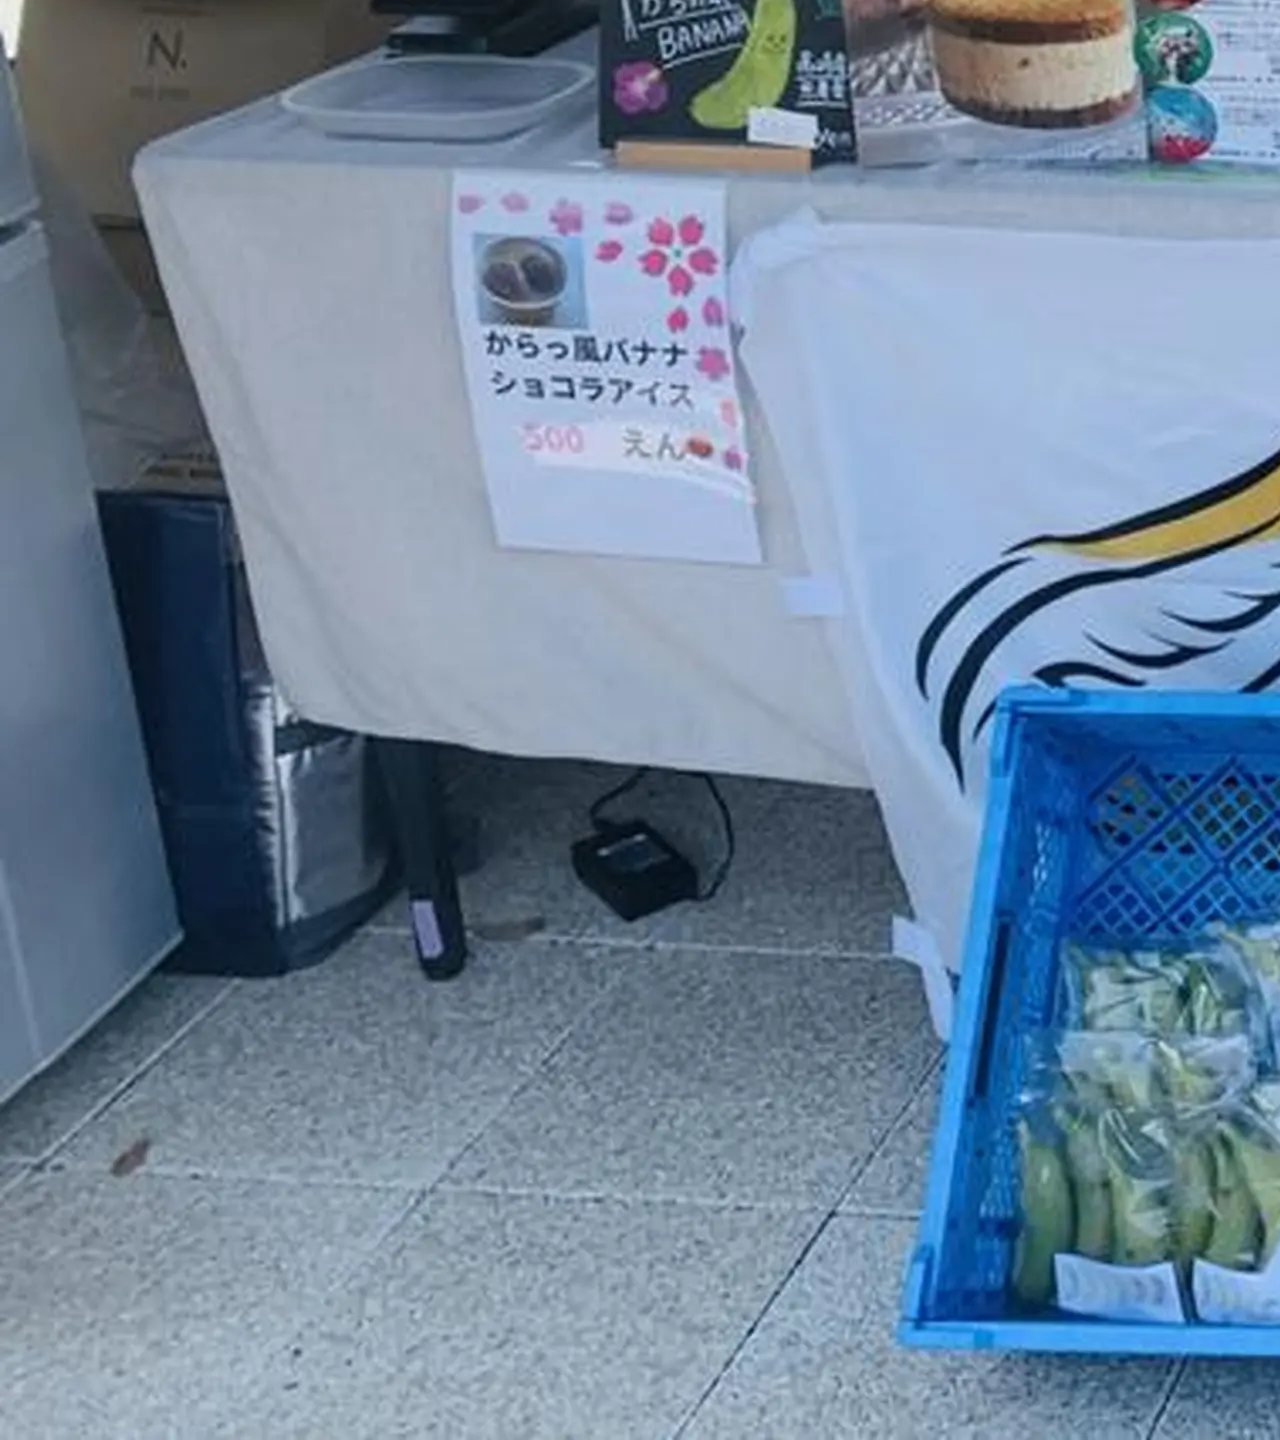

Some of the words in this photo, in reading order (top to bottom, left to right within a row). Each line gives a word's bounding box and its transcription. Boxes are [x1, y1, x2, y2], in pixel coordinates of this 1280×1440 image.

[484, 329, 689, 369] からっ風バナナ
[489, 371, 695, 410] ショコラアイス
